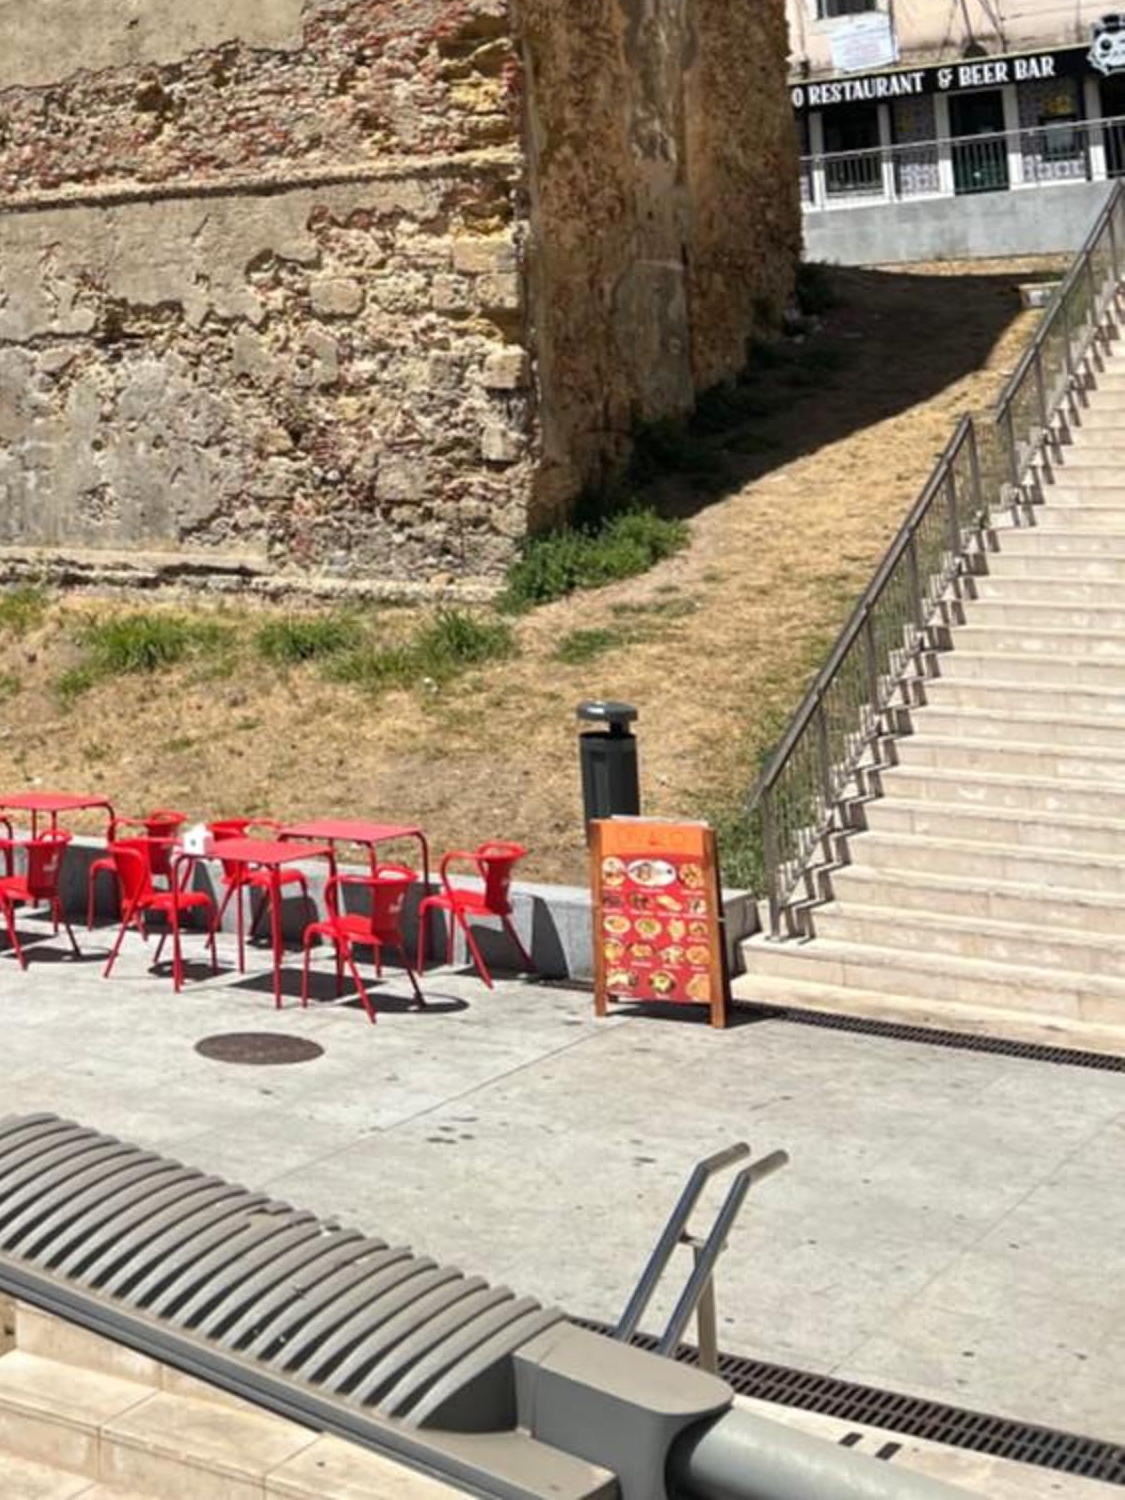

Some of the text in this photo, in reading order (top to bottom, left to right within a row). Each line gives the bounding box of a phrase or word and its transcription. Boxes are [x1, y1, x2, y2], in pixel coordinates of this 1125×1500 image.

[807, 71, 925, 105] RESTAURANT
[958, 61, 1009, 88] BEER
[1014, 55, 1055, 80] BAR
